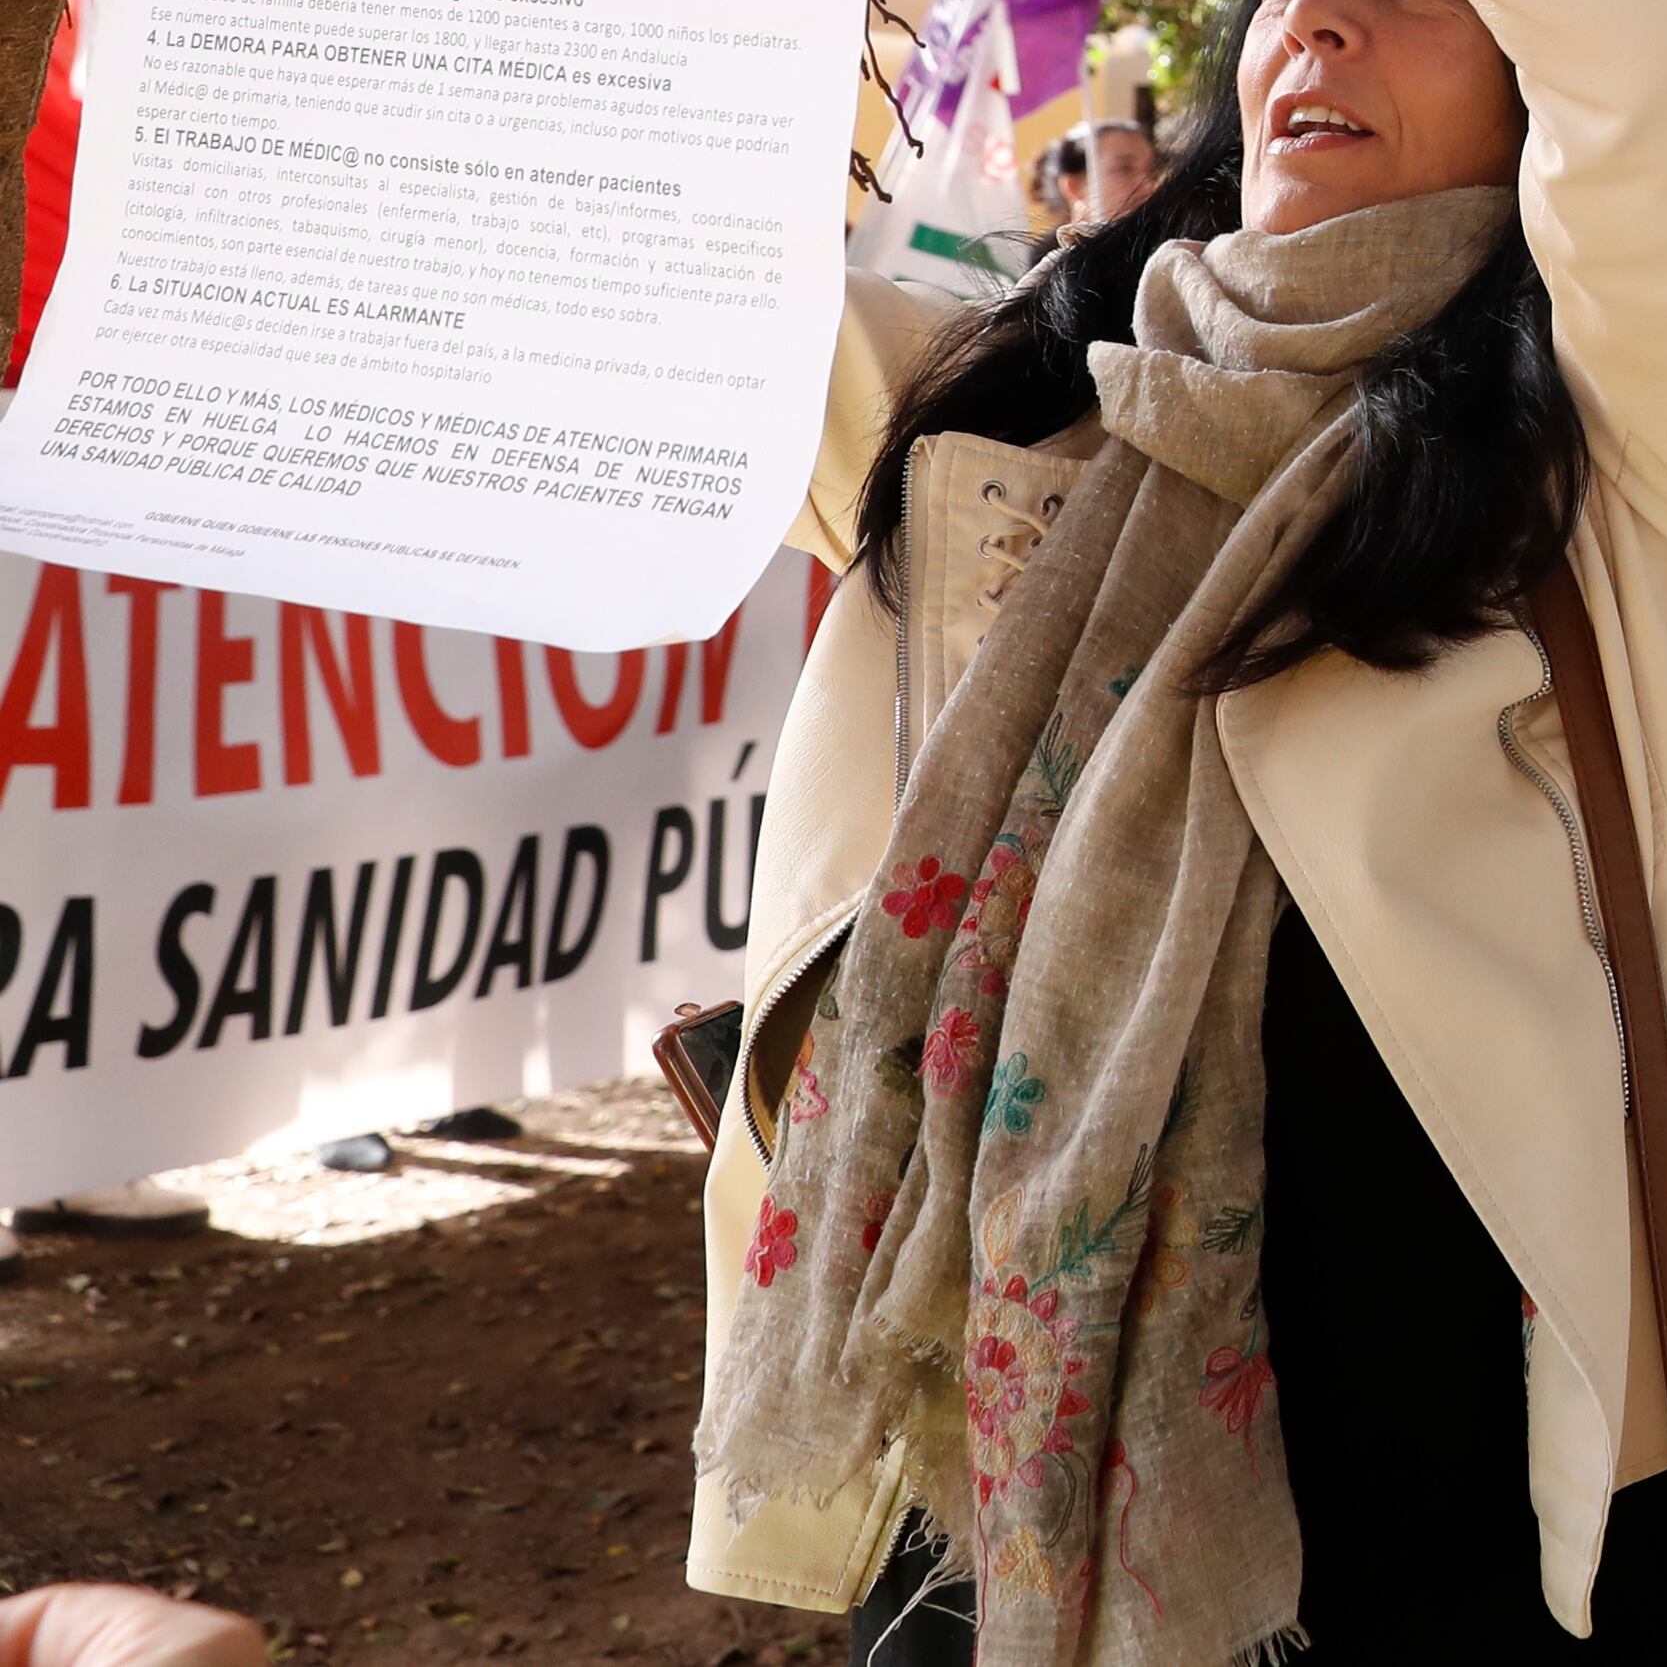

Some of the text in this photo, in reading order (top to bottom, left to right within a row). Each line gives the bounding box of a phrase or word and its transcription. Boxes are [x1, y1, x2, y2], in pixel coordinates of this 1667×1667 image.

[147, 29, 671, 91] 4. La DEMORA PARA OBTENER UNA CITA MÉDICA es excesiva
[135, 126, 681, 197] 5. El TRABAJO DE MÉDIC@ no consiste sólo en atender pacientes
[110, 273, 466, 329] 6. La SITUACION ACTUAL ES ALARMANTE
[78, 370, 747, 469] POR TODO ELLO Y MÁS, LOS MÉDICOS Y MÉDICAS DE ATENCION PRIMARIA
[40, 439, 362, 496] UNA SANIDAD PÚBLICA DE CALIDAD
[53, 418, 733, 520] DERECHOS Y PORQUE QUEREMOS QUE NUESTROS PACIENTES TENGAN
[137, 823, 612, 1060] SANIDAD
